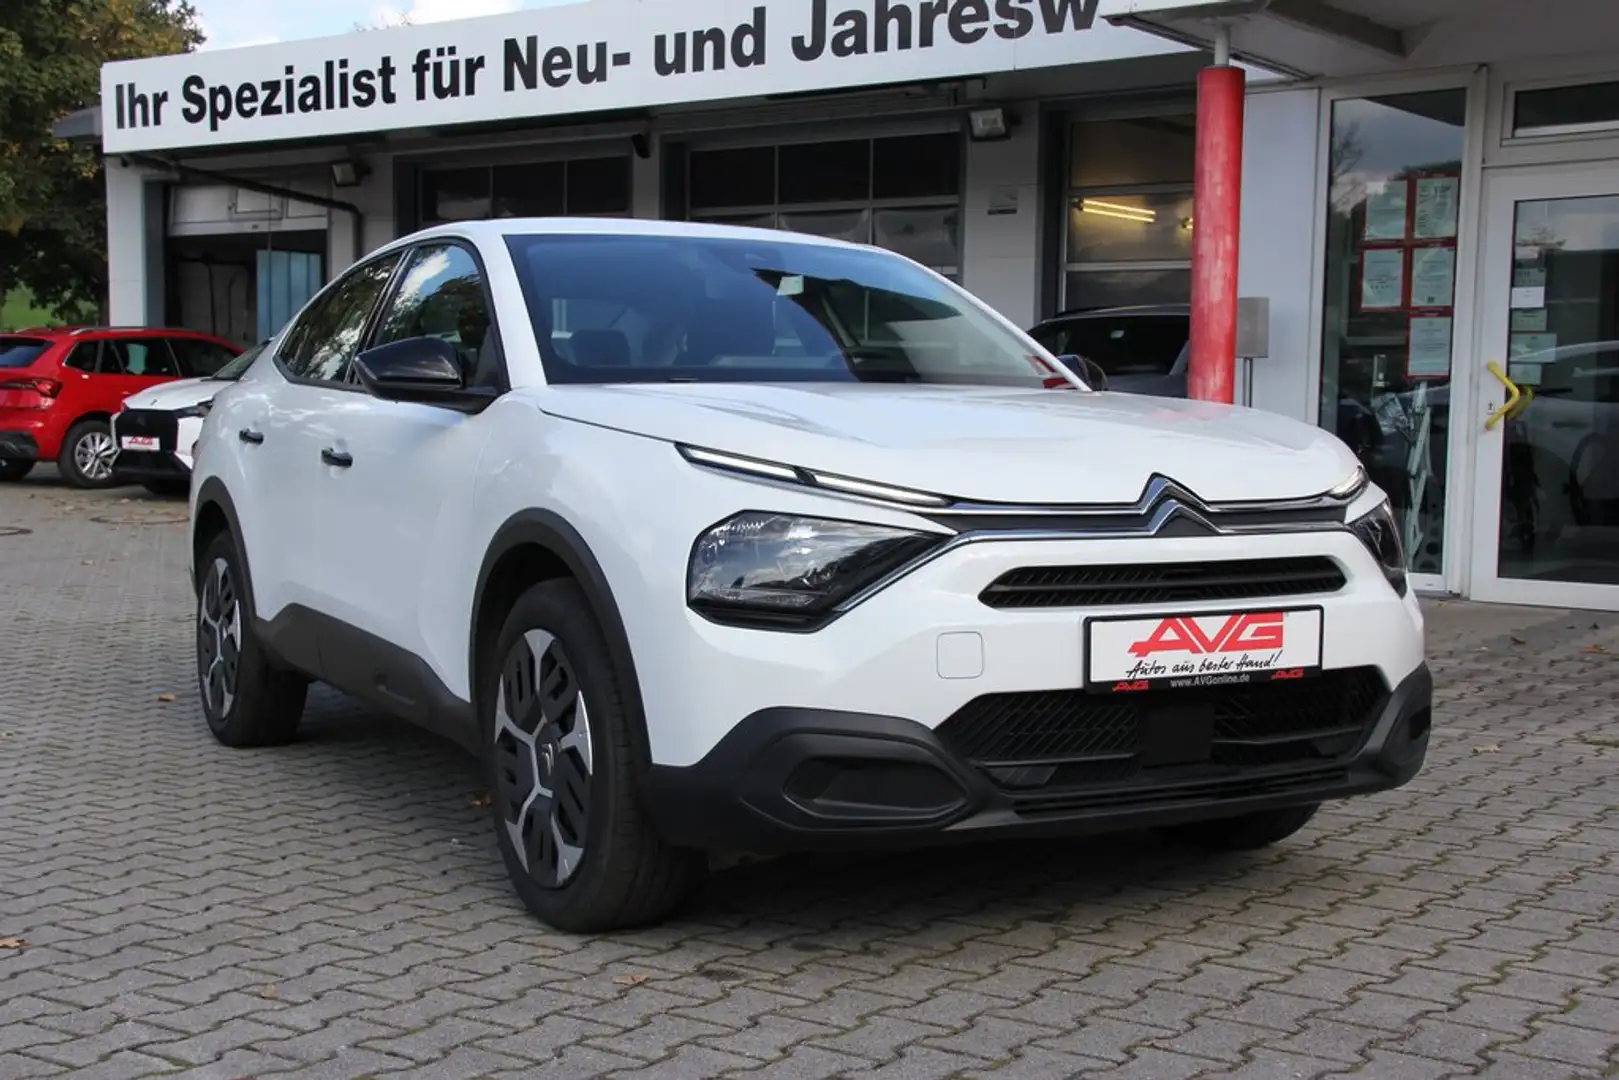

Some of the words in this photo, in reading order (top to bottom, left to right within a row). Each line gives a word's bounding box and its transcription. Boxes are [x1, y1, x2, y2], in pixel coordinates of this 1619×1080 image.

[115, 83, 168, 129] Ihr
[181, 55, 397, 132] Spezialist
[411, 47, 485, 101] für
[503, 35, 631, 92] Neu-
[654, 6, 766, 77] und
[1127, 611, 1284, 658] AVG
[1199, 656, 1233, 672] bester
[1235, 649, 1283, 670] Hand!
[1170, 673, 1250, 688] www.AVGonline.de
